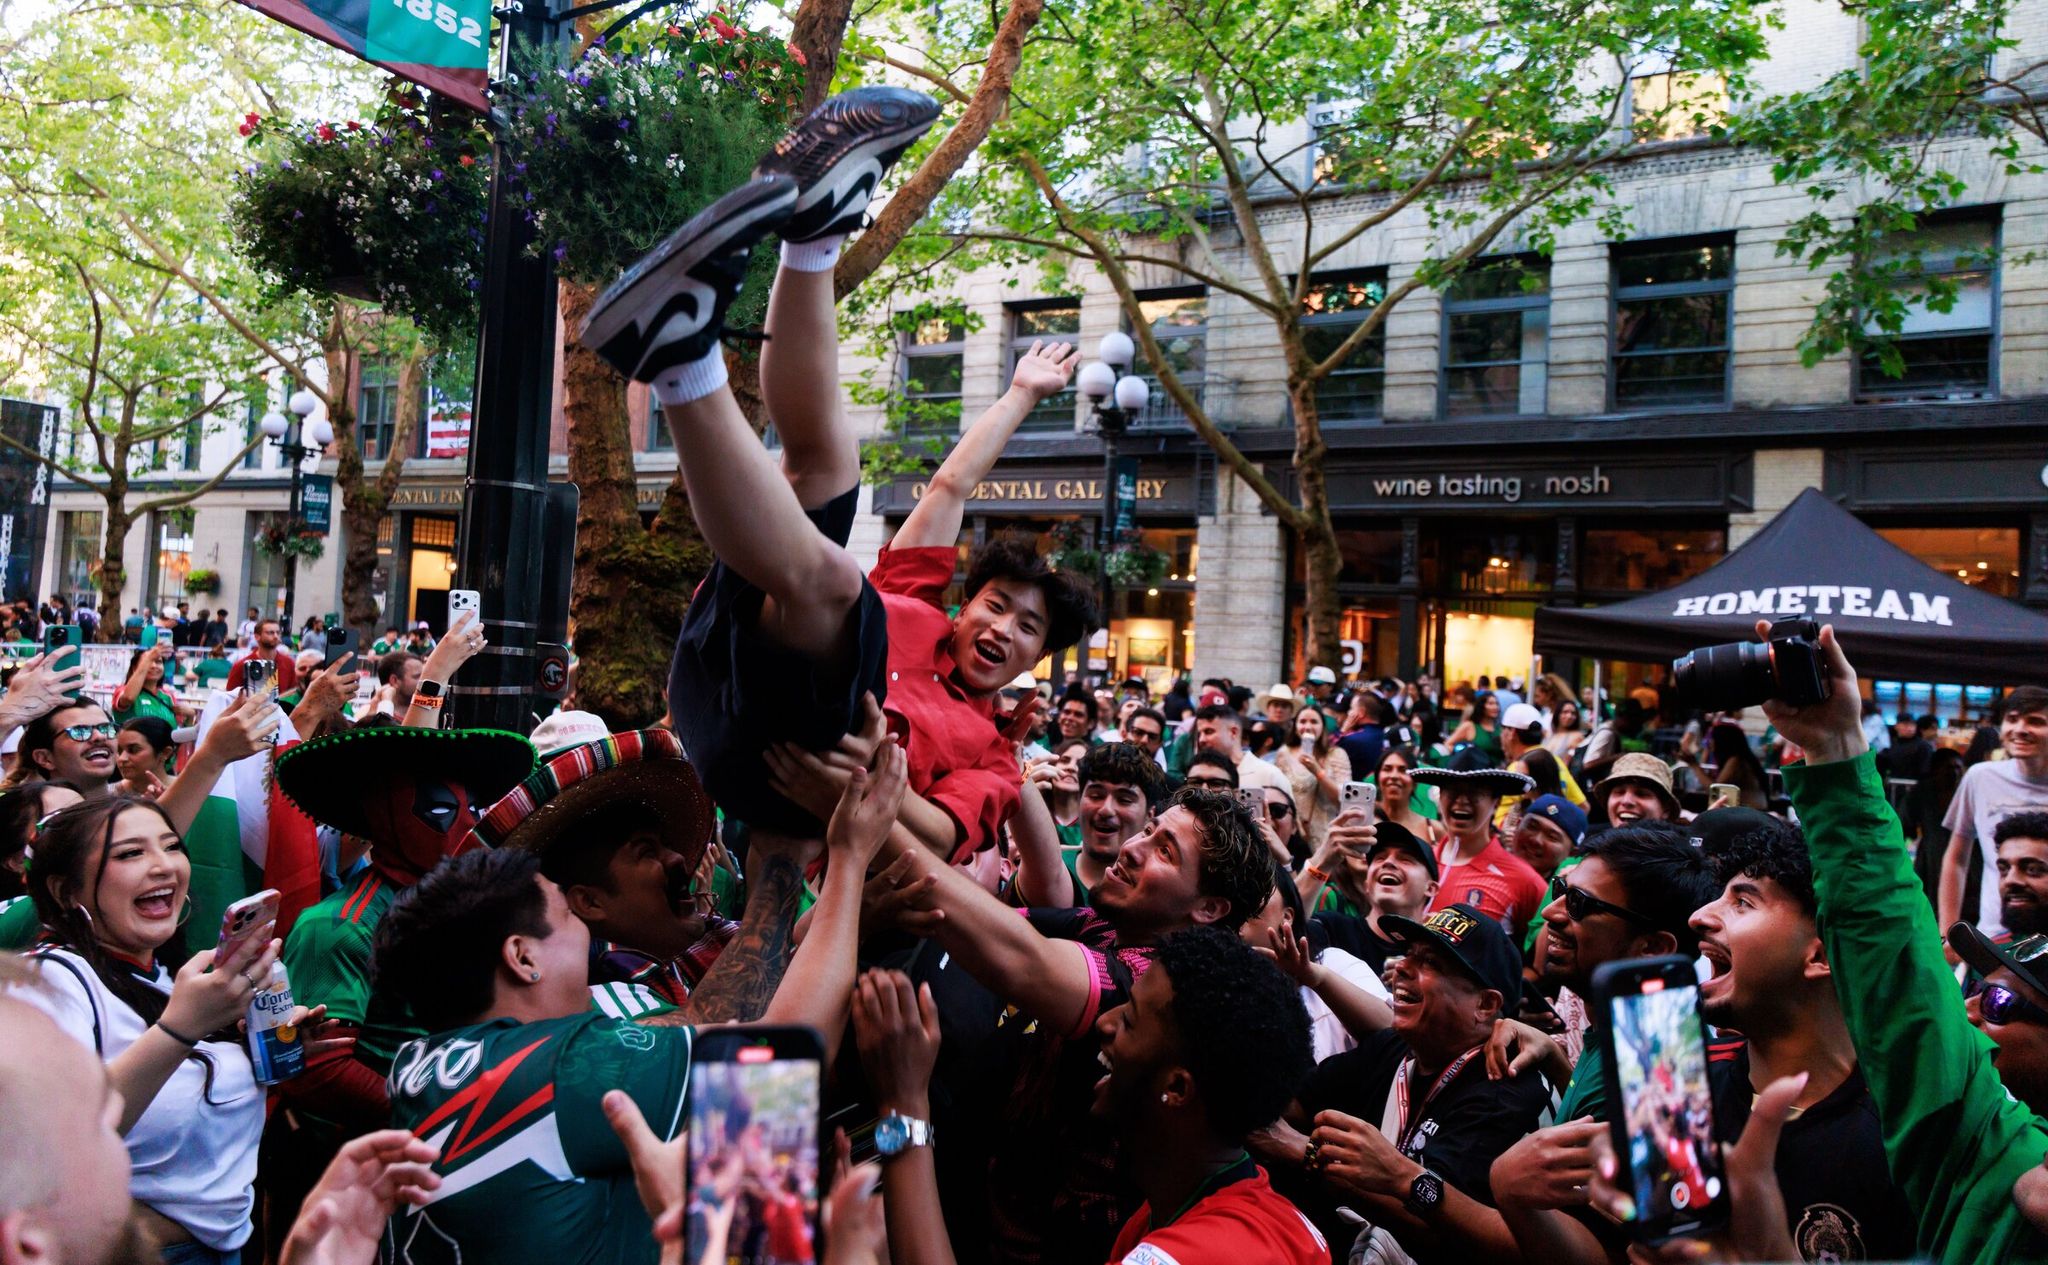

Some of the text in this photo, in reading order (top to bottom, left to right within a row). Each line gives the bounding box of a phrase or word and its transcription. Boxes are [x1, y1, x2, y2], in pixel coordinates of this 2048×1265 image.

[1055, 479, 1168, 499] GALRY
[1373, 466, 1610, 502] wine tasting nosh
[1672, 585, 1953, 626] HOMETEAM
